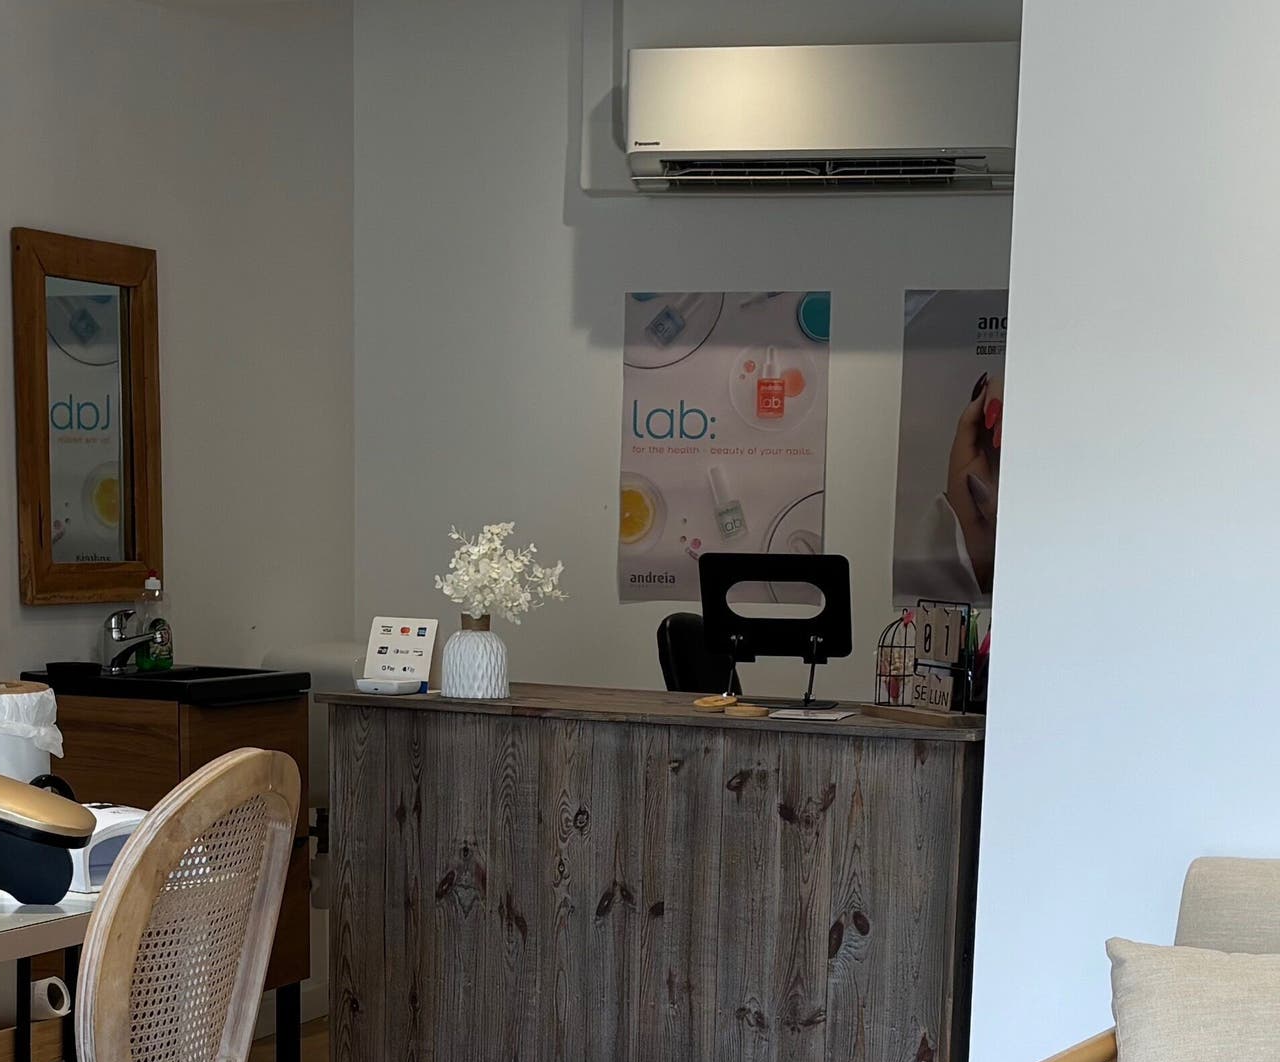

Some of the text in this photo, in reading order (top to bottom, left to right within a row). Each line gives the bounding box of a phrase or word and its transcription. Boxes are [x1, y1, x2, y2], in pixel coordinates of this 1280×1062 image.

[632, 399, 717, 440] lab:
[648, 445, 665, 455] the
[667, 446, 700, 456] health
[630, 571, 677, 584] andreia
